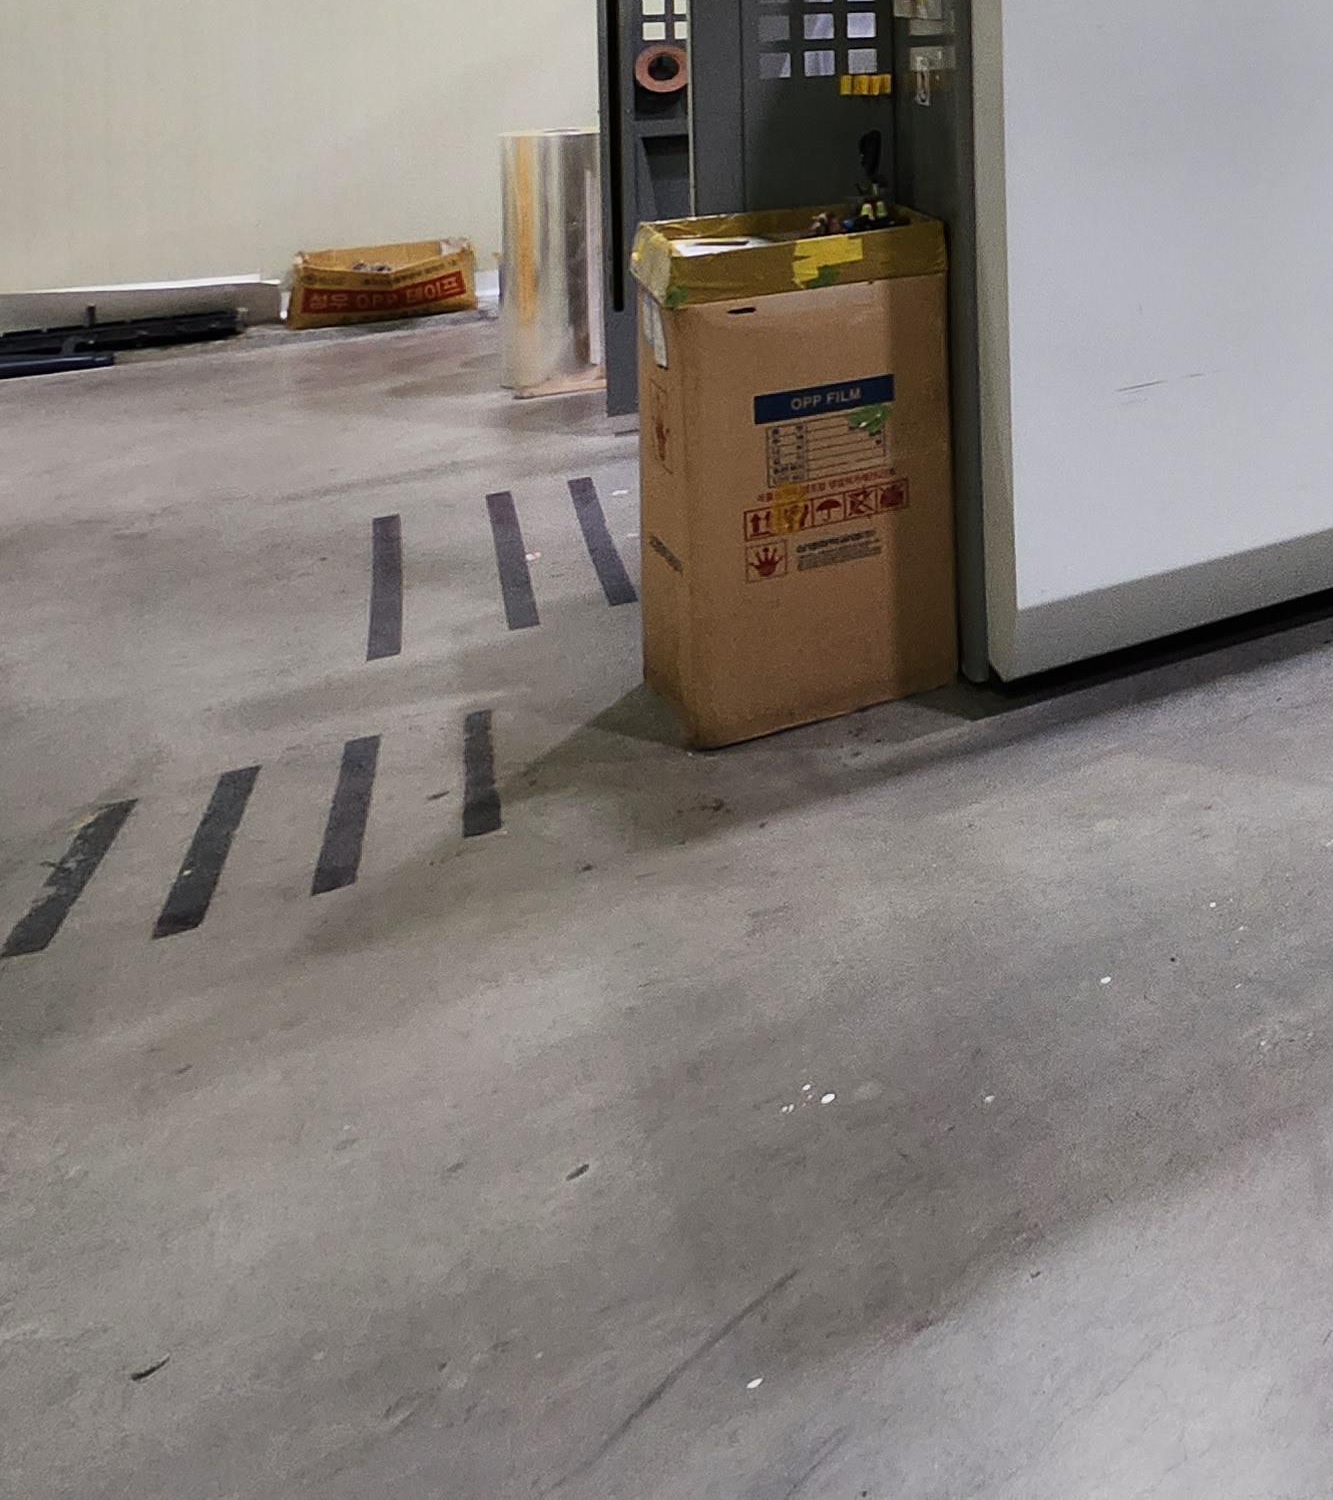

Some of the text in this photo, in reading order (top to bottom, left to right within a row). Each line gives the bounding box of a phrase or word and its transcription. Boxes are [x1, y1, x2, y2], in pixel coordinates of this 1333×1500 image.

[309, 275, 461, 311] 성우 OPP 테이프
[791, 387, 862, 411] OPP FILM
